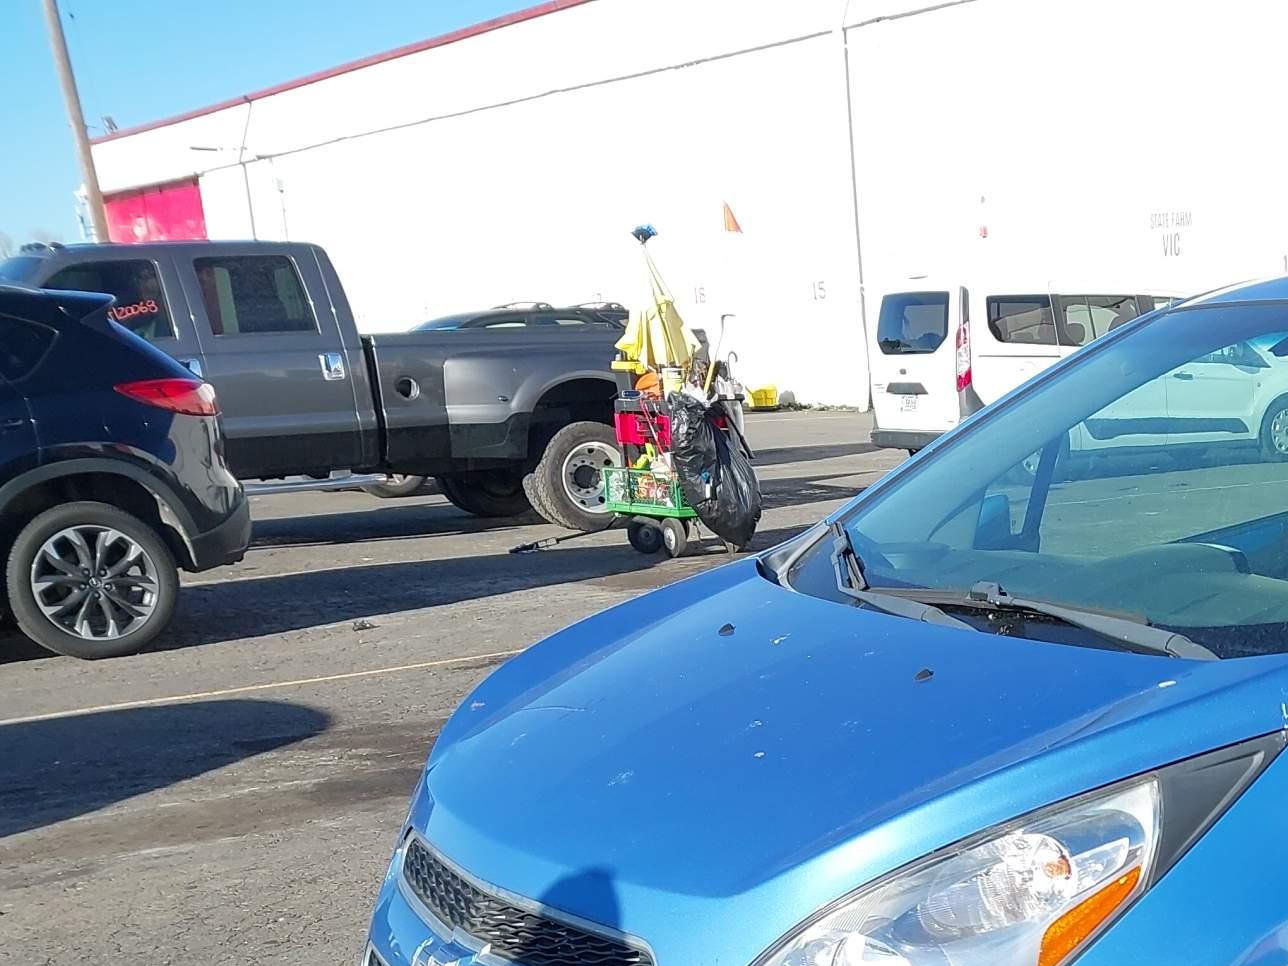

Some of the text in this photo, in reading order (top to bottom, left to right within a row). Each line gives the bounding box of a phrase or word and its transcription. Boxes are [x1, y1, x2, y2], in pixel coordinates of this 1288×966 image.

[1150, 212, 1192, 229] STATE FARM
[1162, 232, 1181, 256] VIC
[813, 280, 827, 300] 15
